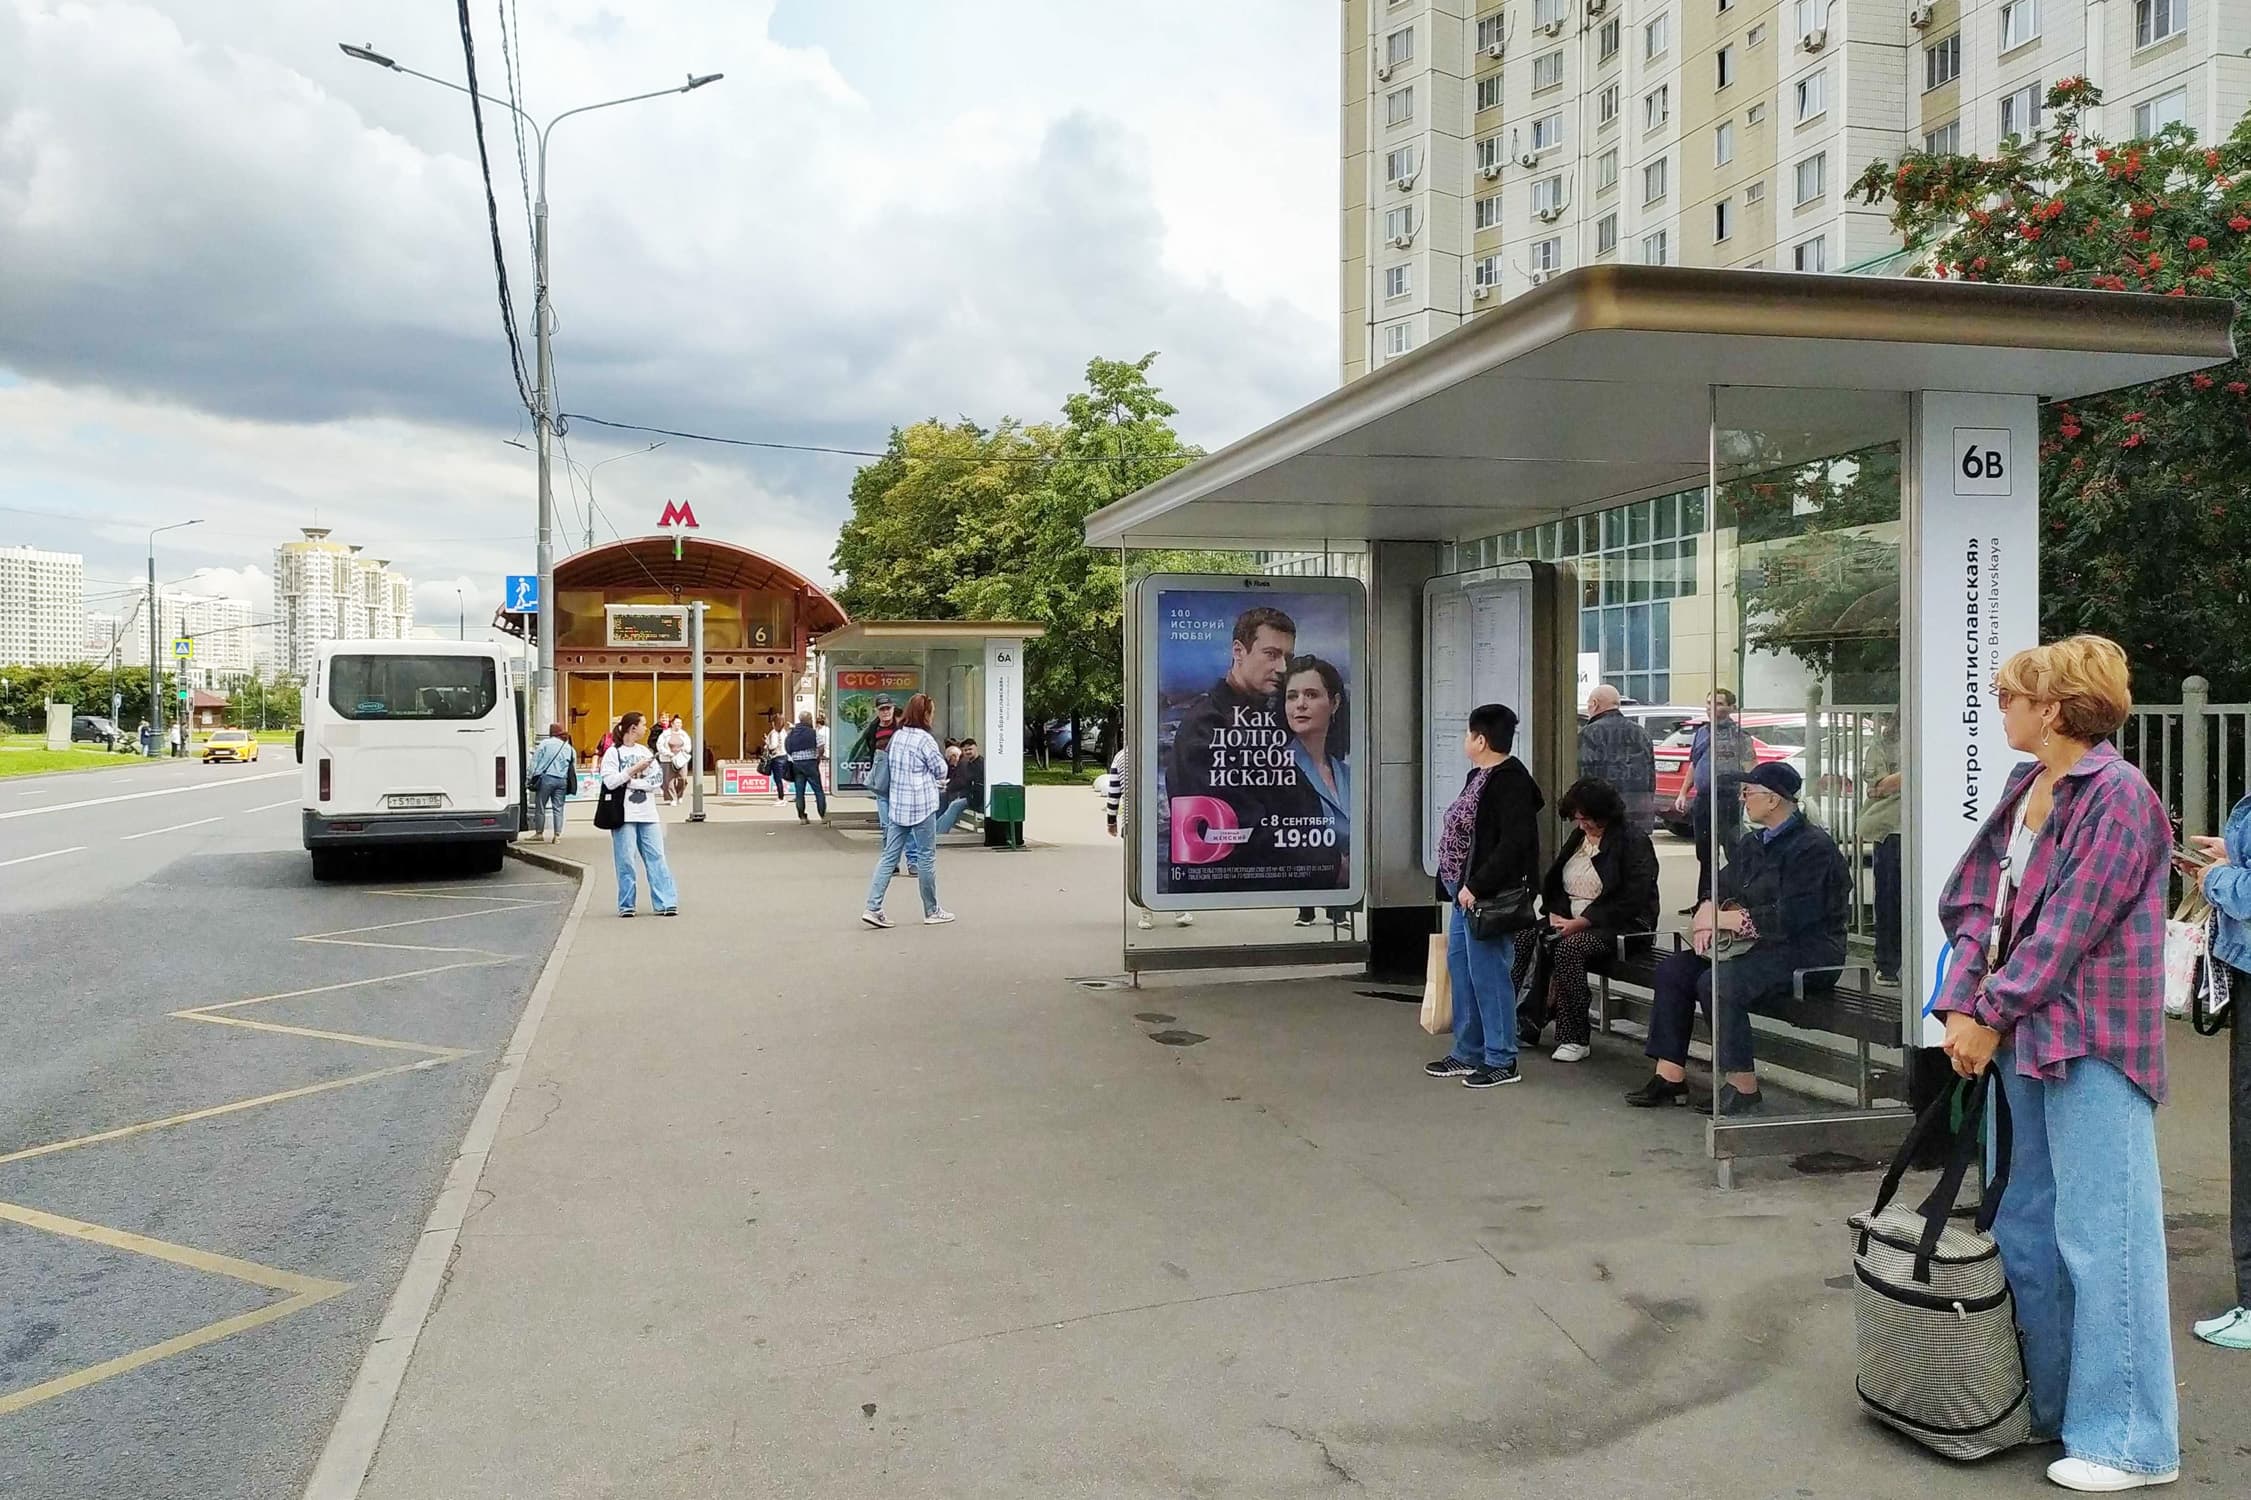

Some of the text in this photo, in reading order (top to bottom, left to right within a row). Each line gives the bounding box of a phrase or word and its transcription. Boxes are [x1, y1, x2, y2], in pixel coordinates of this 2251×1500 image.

[1988, 537, 2001, 646] Bratislavskaya
[1170, 609, 1191, 617] 100
[1170, 618, 1225, 629] ИСТОРИЙ
[755, 627, 767, 642] 6
[1170, 631, 1212, 640] ЛЮБВИ
[844, 673, 877, 686] СТС
[880, 678, 912, 686] 19:00
[1962, 537, 1981, 823] Метро «Братиславская»
[1232, 705, 1277, 727] Как
[1208, 728, 1288, 748] долго
[1212, 742, 1296, 767] я тебя
[742, 778, 767, 786] ЛЕТО
[1209, 768, 1297, 787] искала
[1270, 814, 1279, 826] 8
[1282, 816, 1336, 826] СЕНТЯБРЯ
[1273, 828, 1336, 848] 19:00
[1170, 867, 1187, 881] 16+
